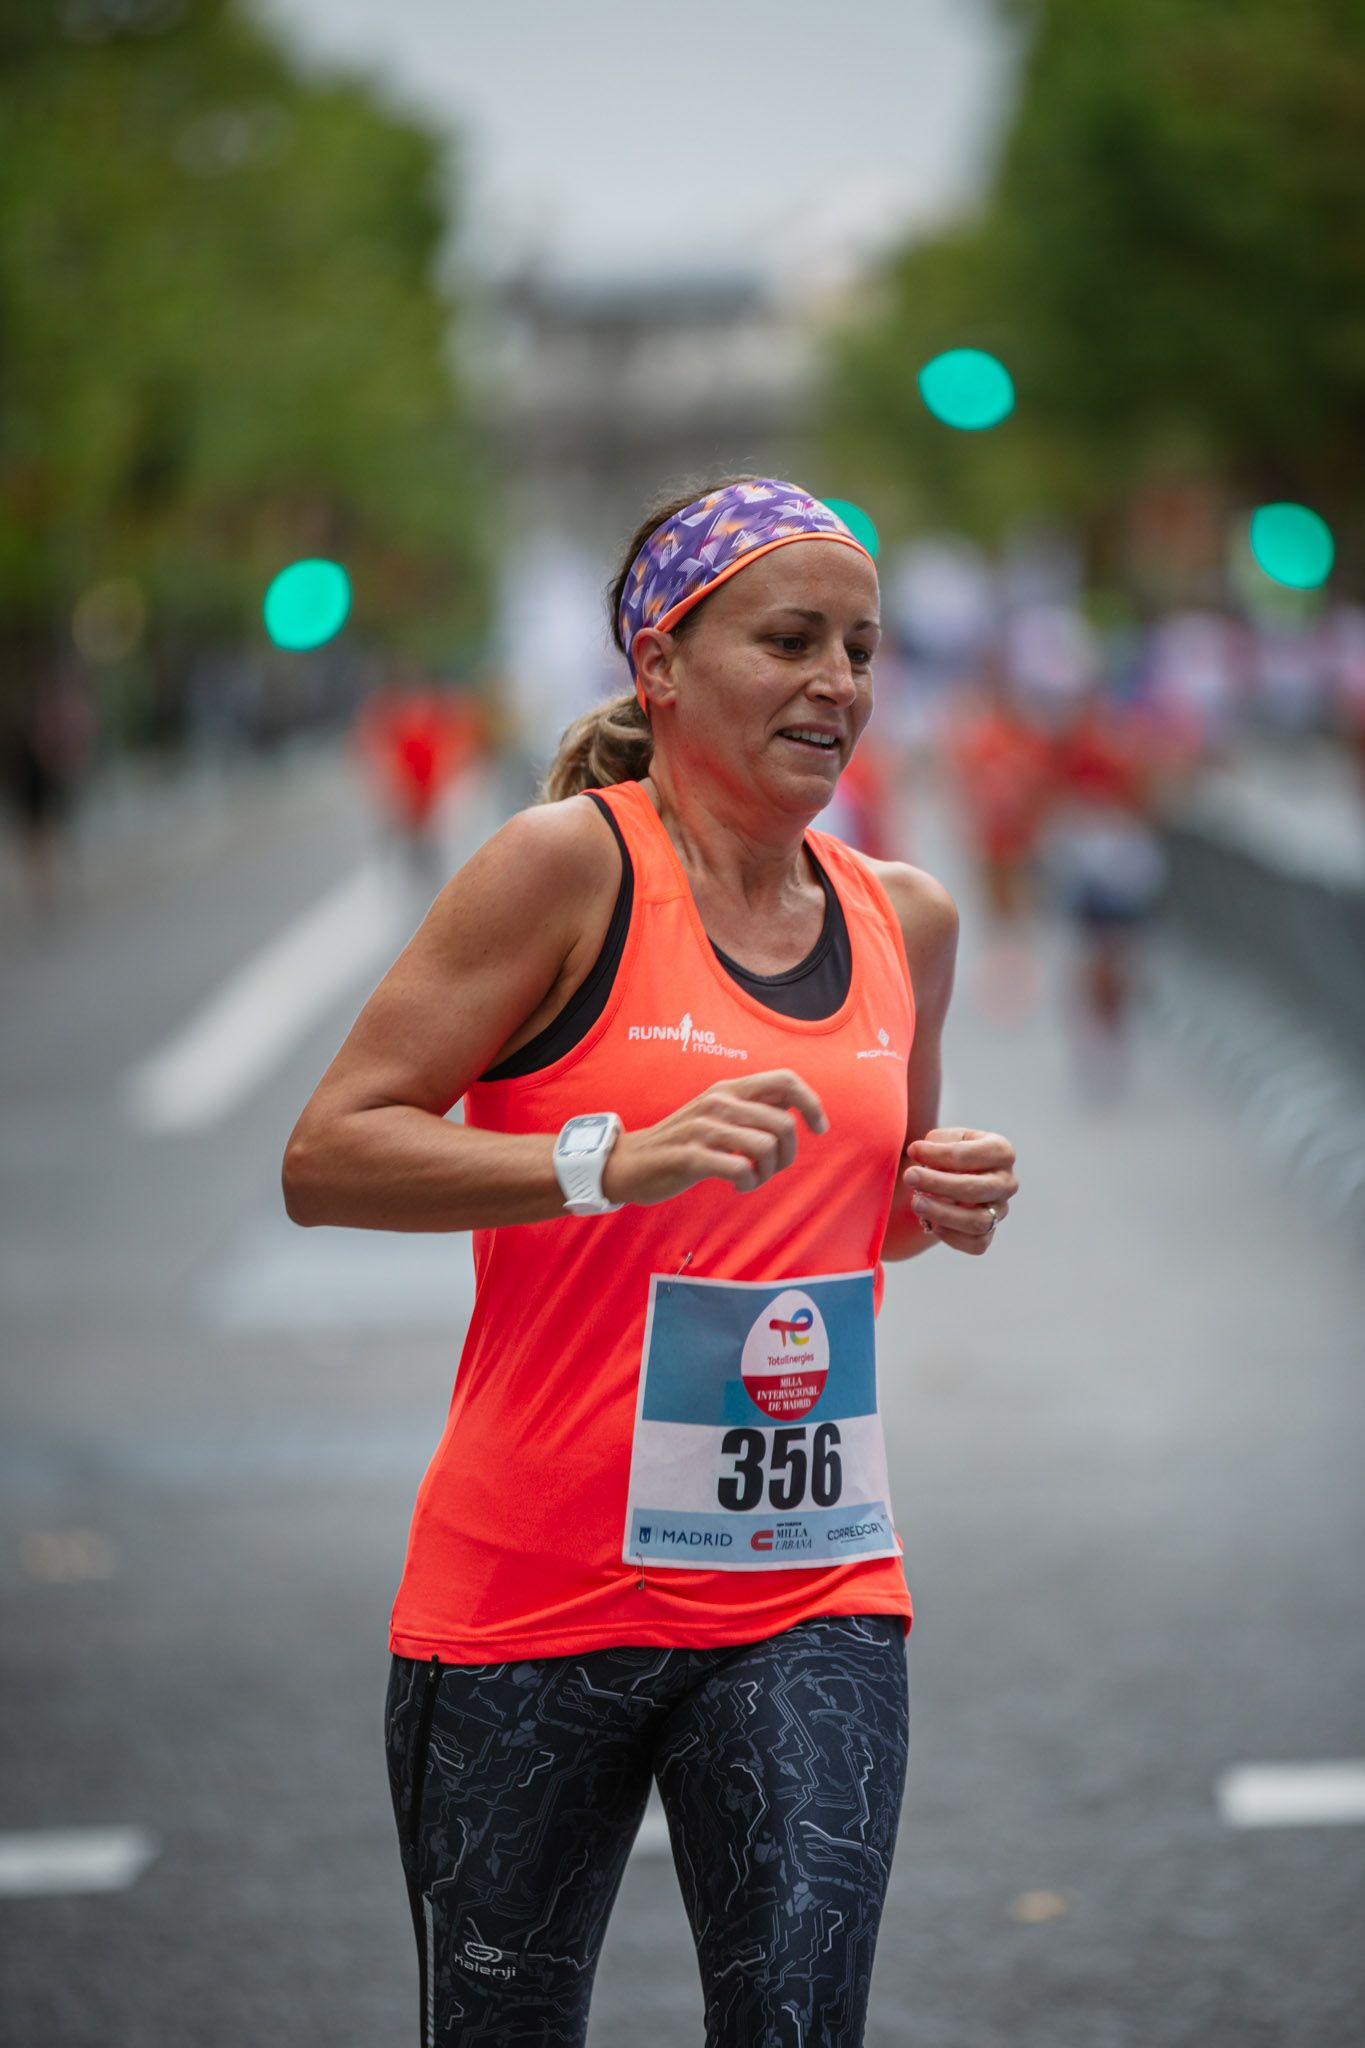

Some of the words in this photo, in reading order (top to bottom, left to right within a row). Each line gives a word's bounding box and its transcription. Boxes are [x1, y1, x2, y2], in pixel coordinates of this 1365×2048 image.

[692, 1042, 748, 1061] mothers
[780, 1376, 803, 1388] MILLA
[768, 1401, 782, 1412] DE
[782, 1398, 811, 1411] MADRID
[717, 1422, 842, 1512] 356
[662, 1529, 733, 1547] MADRID
[776, 1528, 808, 1539] MILLA
[774, 1539, 813, 1550] URBANA
